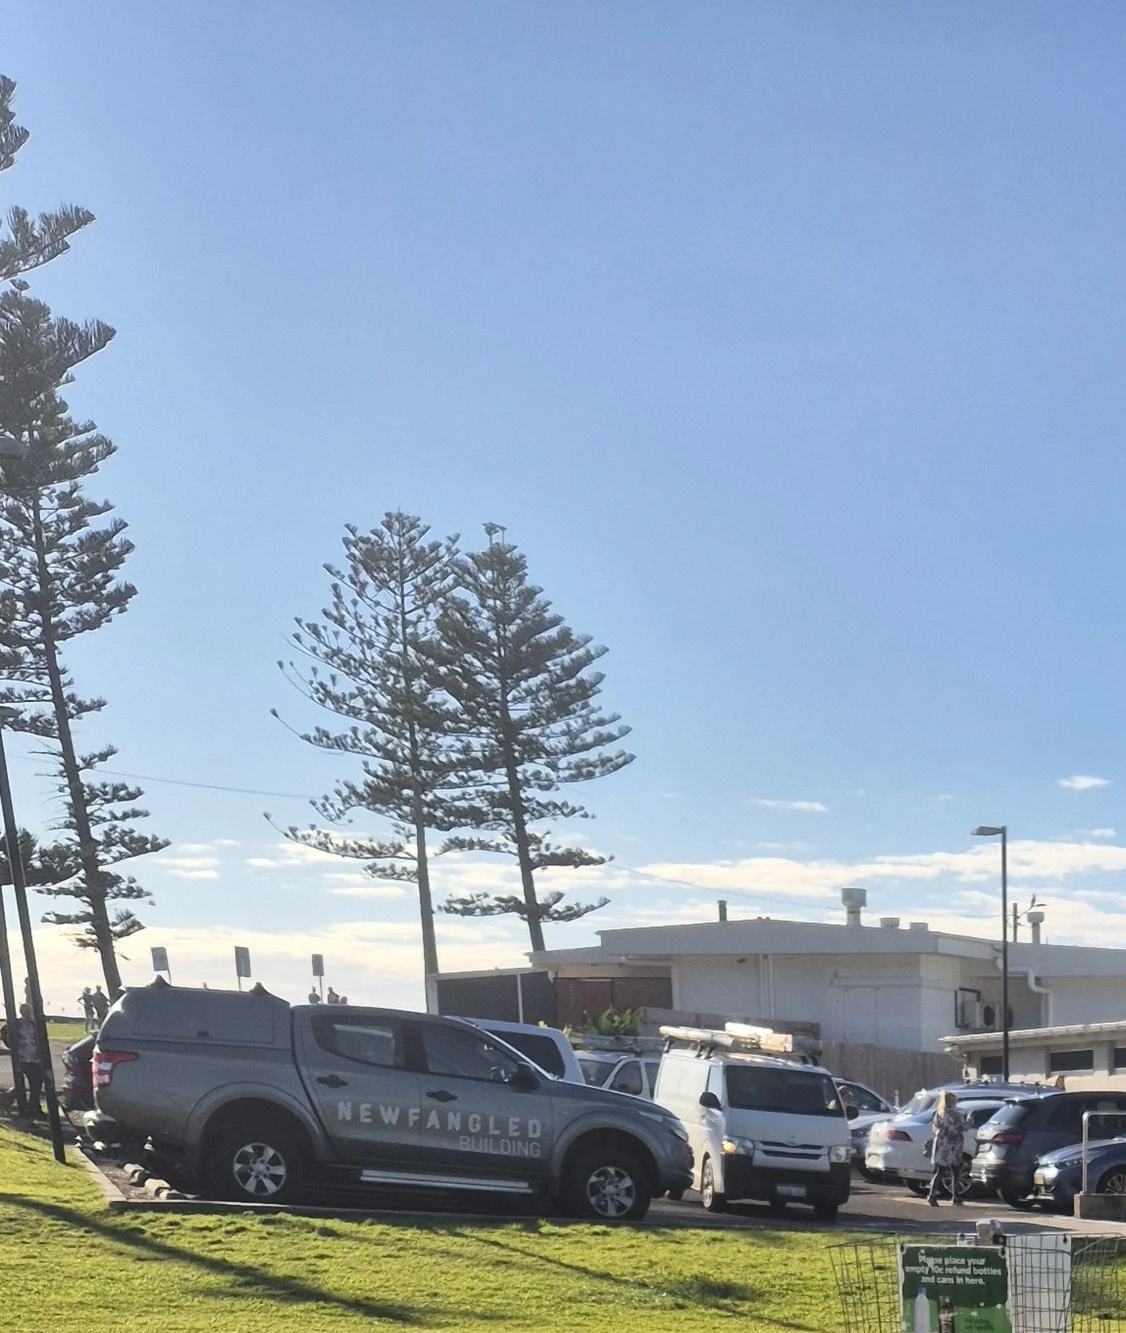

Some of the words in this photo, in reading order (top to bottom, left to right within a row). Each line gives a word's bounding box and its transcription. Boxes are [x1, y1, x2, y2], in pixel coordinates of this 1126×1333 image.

[338, 1101, 541, 1138] NEWFANGLED
[459, 1135, 541, 1158] BUILDING
[945, 1257, 965, 1266] place
[967, 1258, 986, 1267] your
[905, 1266, 928, 1275] empty
[945, 1266, 971, 1275] refund
[973, 1266, 1002, 1276] bottles
[921, 1276, 935, 1284] and
[936, 1276, 954, 1285] cans
[956, 1276, 964, 1285] in
[965, 1276, 985, 1286] here.
